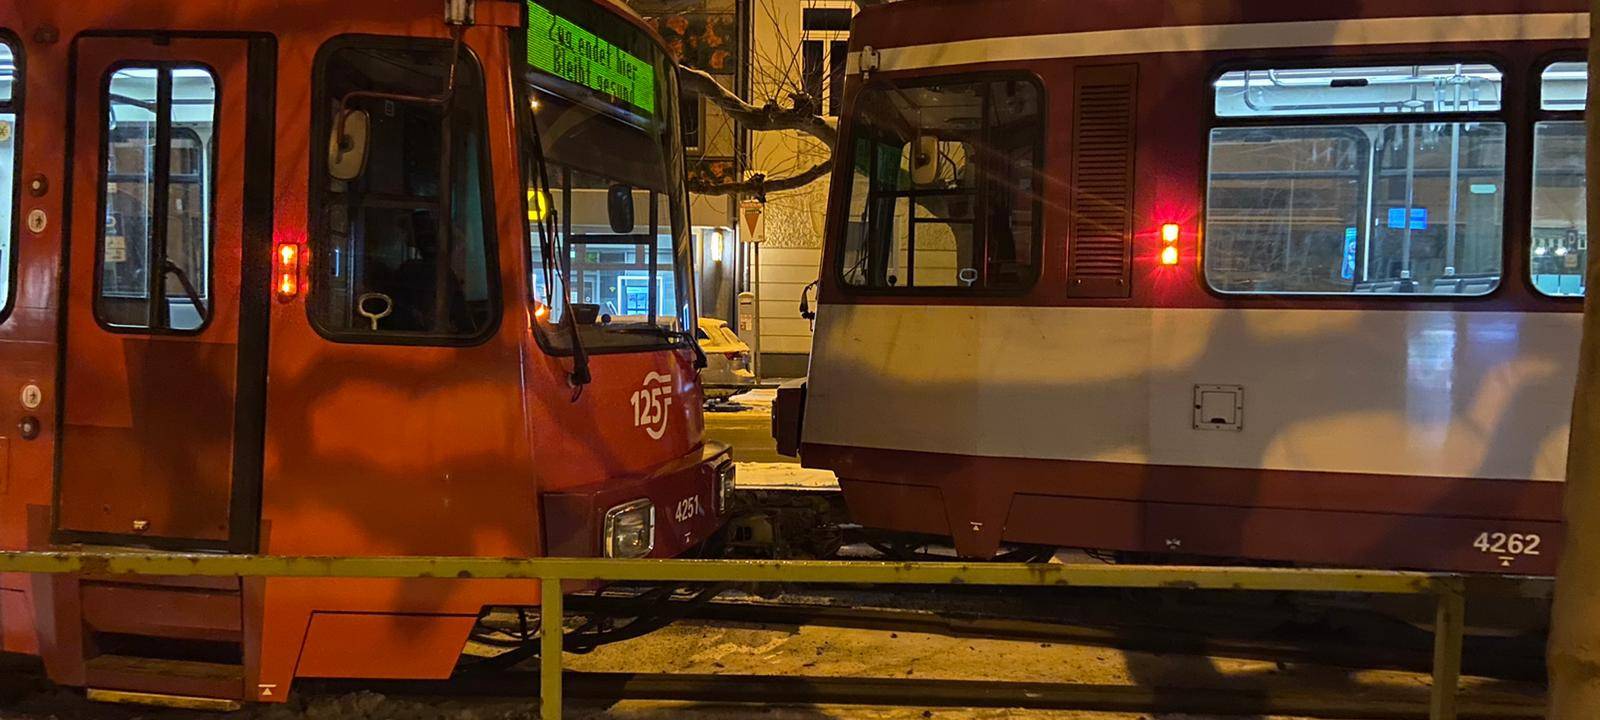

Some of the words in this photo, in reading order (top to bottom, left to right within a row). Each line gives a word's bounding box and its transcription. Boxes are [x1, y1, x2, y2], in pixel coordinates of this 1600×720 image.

[546, 15, 575, 54] Zug
[578, 37, 611, 69] endet
[616, 47, 638, 80] hier
[553, 44, 590, 86] Bleibt
[597, 70, 636, 104] gesund
[675, 494, 700, 523] 4251
[1473, 532, 1541, 555] 4262
